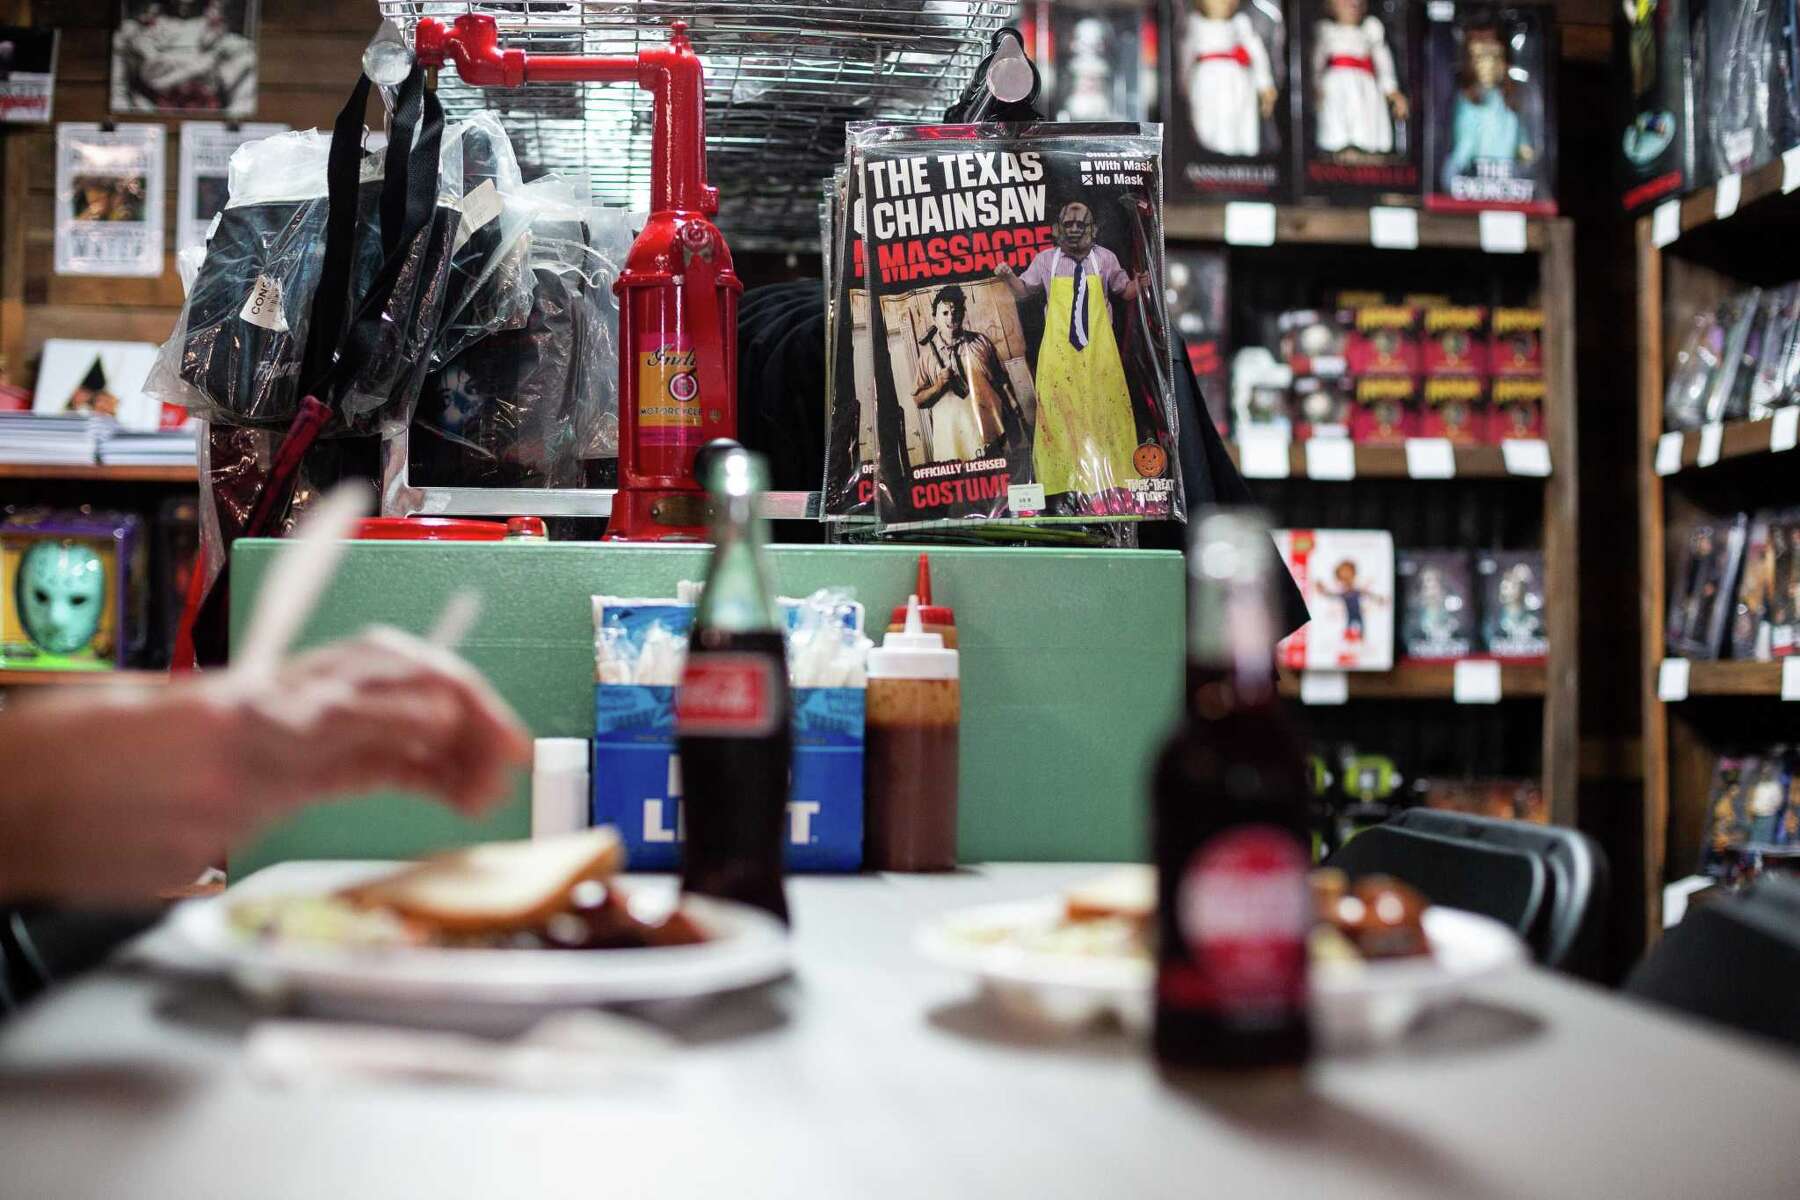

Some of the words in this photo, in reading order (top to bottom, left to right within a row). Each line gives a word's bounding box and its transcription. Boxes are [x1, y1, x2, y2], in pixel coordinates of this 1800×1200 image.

[867, 156, 932, 199] THE
[937, 151, 1044, 190] TEXAS
[1094, 160, 1120, 171] With
[1123, 160, 1153, 172] Mask
[1095, 174, 1111, 185] No
[1113, 173, 1144, 185] Mask
[872, 184, 1046, 240] CHAINSAW
[913, 463, 962, 479] OFFICIALLY
[966, 458, 1006, 473] LICENSED
